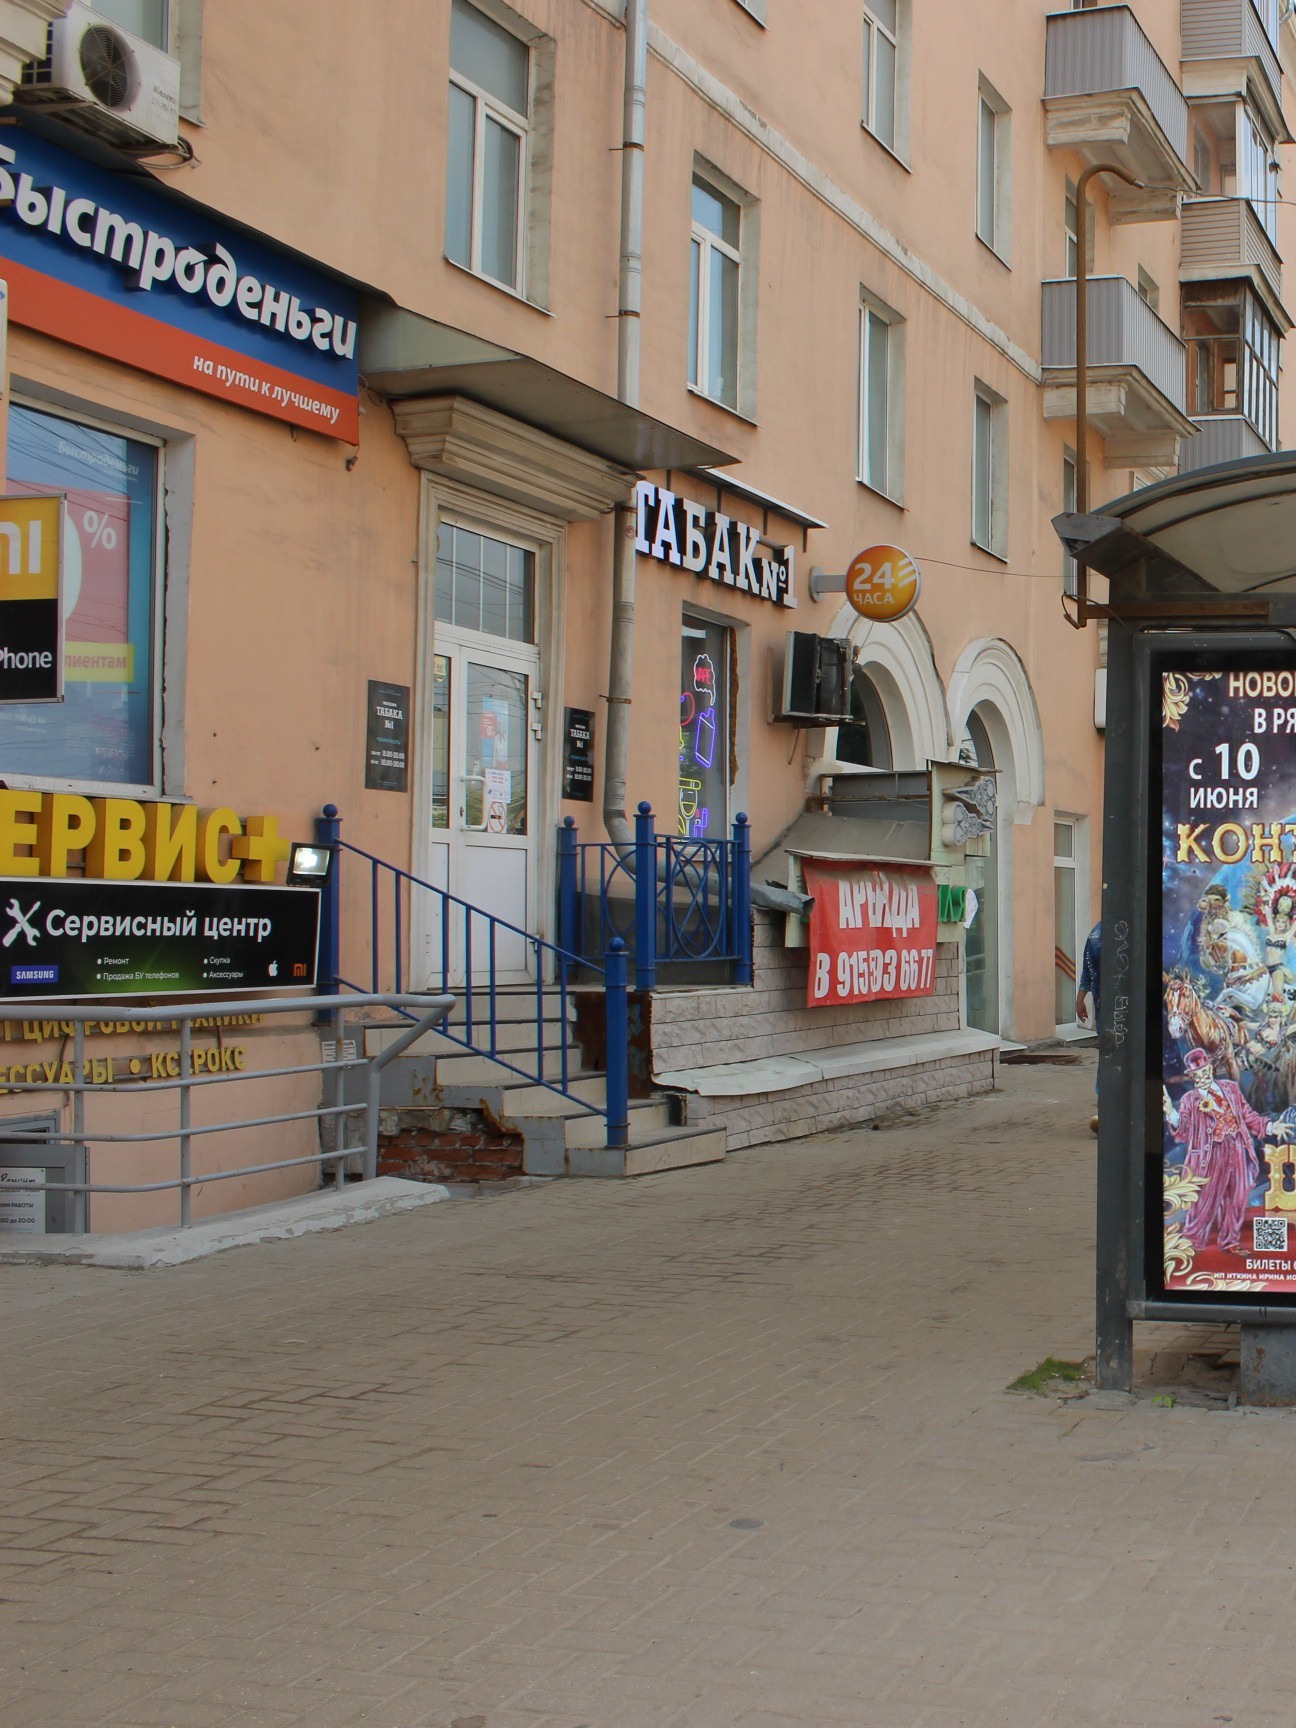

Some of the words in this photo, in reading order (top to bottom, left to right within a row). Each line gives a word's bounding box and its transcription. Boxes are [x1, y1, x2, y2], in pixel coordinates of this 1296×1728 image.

[193, 356, 213, 375] на
[217, 365, 259, 392] пути
[261, 382, 271, 396] к
[272, 386, 339, 424] лучшему
[853, 562, 894, 590] 24
[854, 592, 894, 605] ЧАСА
[1254, 708, 1266, 734] В
[1215, 743, 1260, 781] 10
[1189, 787, 1259, 809] ИЮНЯ
[46, 909, 196, 942] Сервисный
[204, 912, 271, 943] центр
[104, 957, 129, 965] Ремонт
[209, 957, 231, 966] Скупка
[16, 970, 54, 980] SAMSUNG
[103, 972, 133, 982] Продажа
[135, 972, 144, 980] БУ
[145, 971, 179, 980] телефонов
[209, 970, 244, 980] Аксессуары
[152, 1046, 247, 1078] КСРОКС
[1246, 1258, 1290, 1270] БИЛЕТЫ
